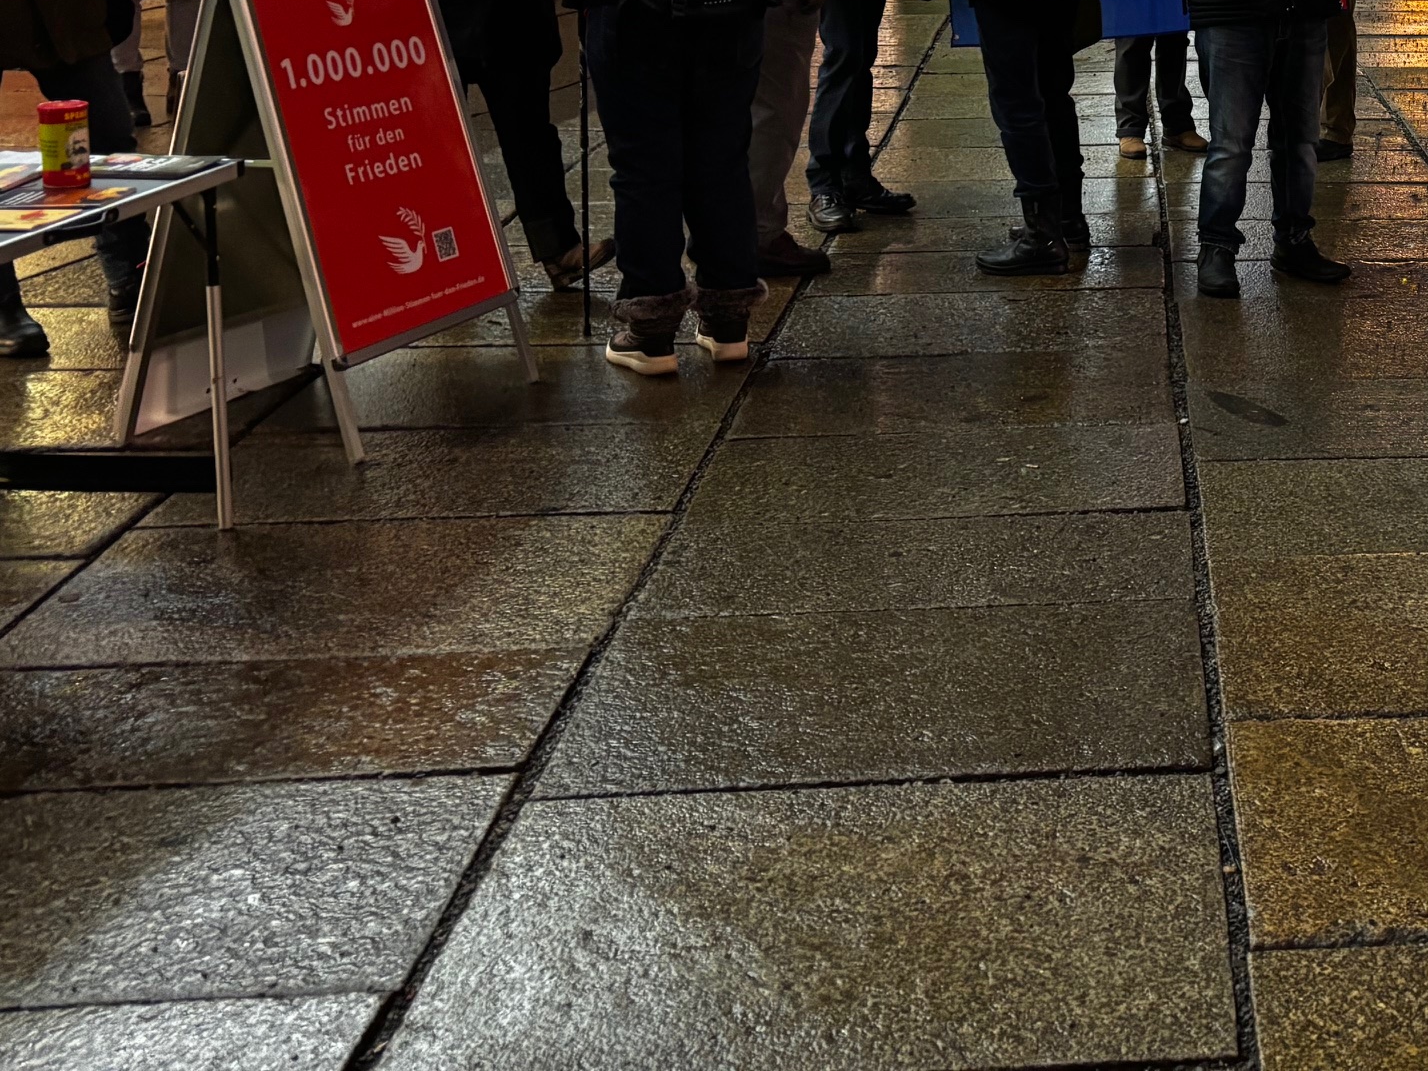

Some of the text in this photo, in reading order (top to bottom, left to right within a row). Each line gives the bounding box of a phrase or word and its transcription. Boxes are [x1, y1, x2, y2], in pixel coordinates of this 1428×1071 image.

[280, 36, 426, 90] 1.000.000
[324, 95, 413, 130] Stimmen
[347, 128, 405, 154] für den
[344, 149, 423, 186] Frieden
